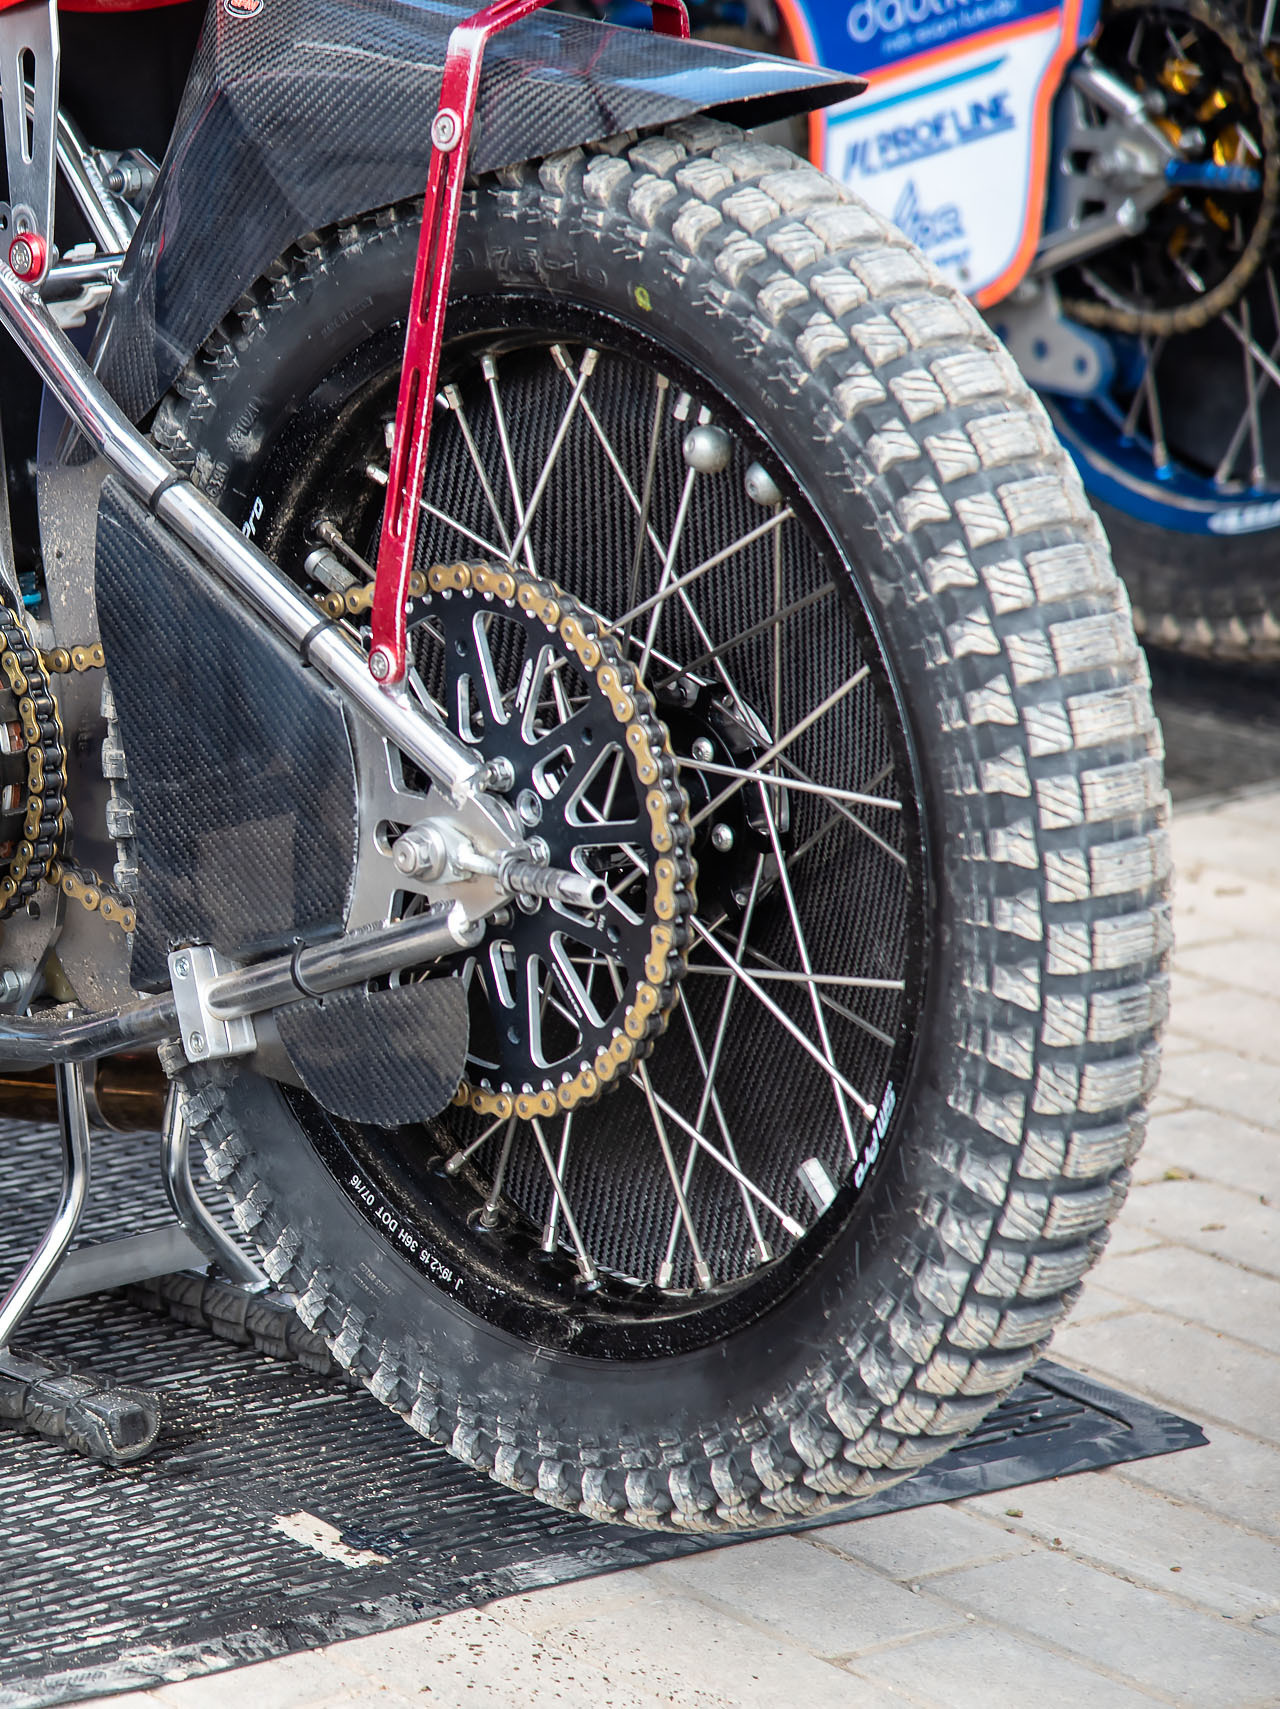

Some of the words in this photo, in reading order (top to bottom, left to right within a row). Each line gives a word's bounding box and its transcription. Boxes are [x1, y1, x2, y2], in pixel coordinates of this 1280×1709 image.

[350, 1174, 376, 1206] 07/16
[374, 1206, 399, 1233] DOT
[397, 1228, 419, 1252] 36H
